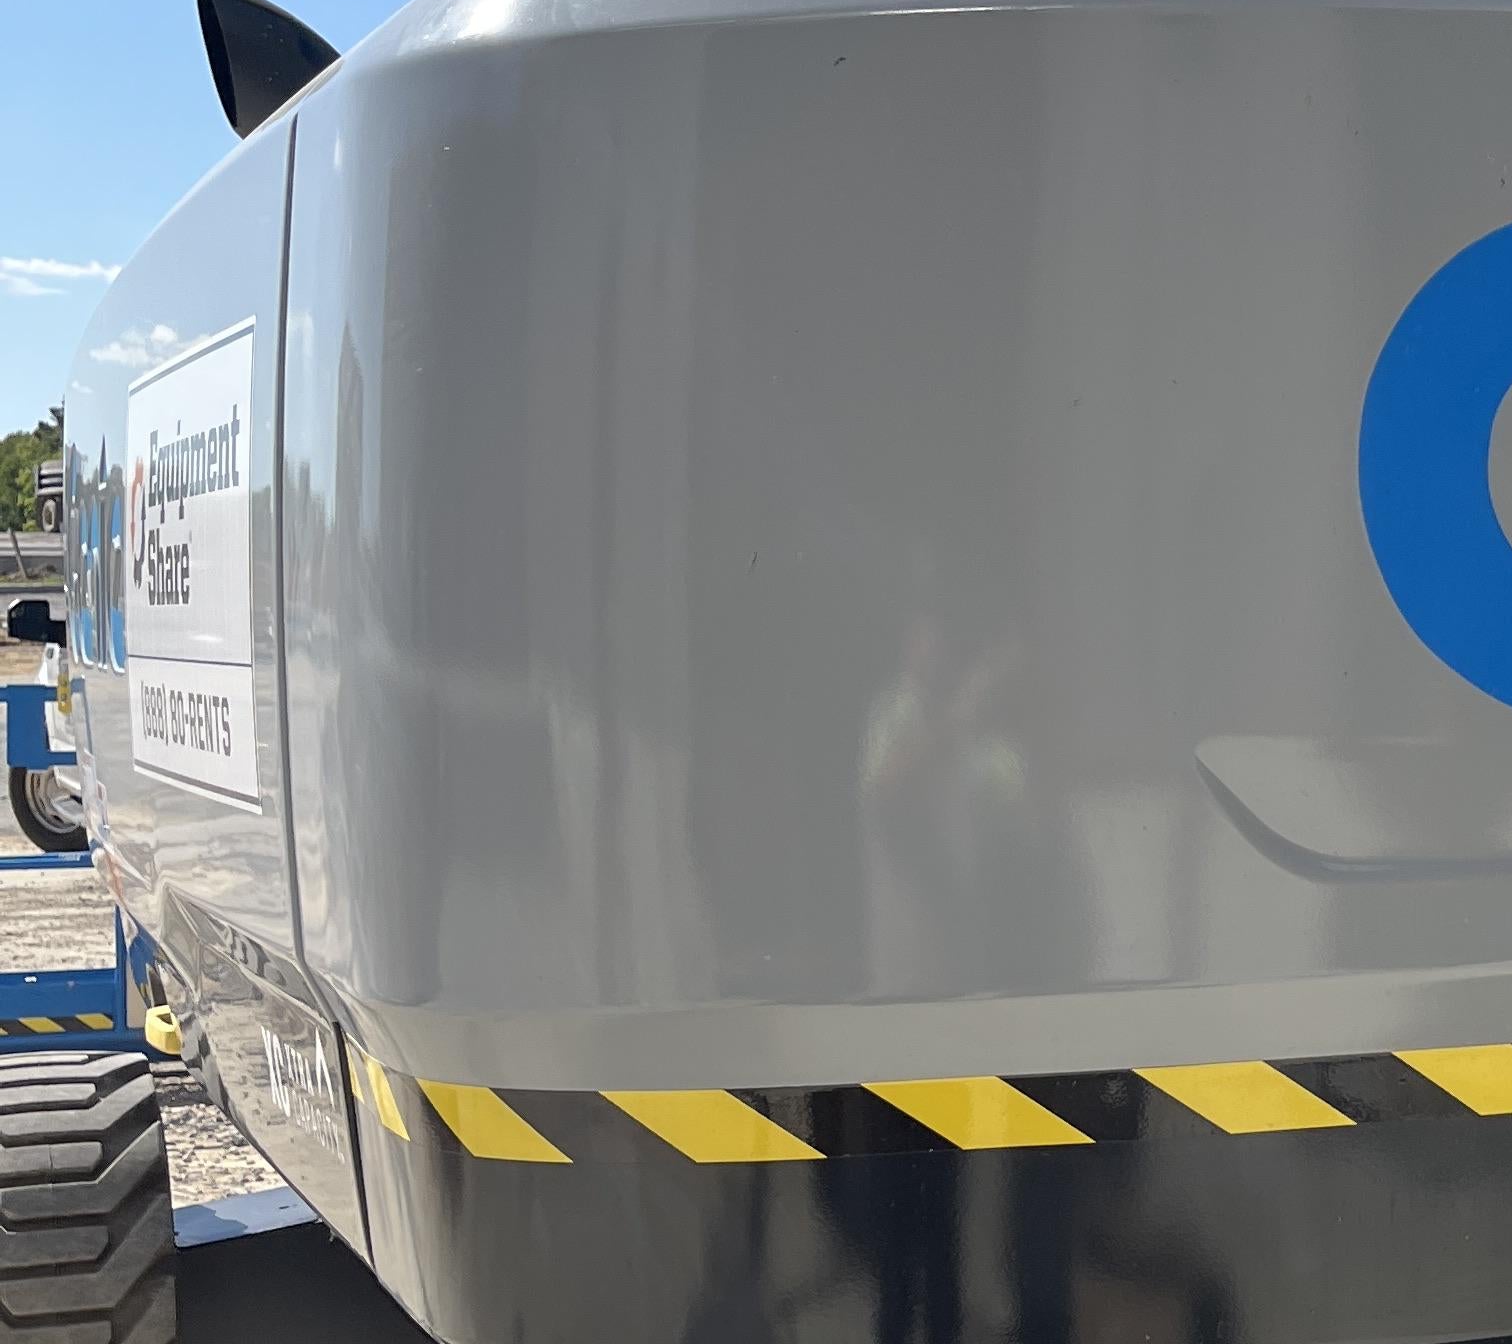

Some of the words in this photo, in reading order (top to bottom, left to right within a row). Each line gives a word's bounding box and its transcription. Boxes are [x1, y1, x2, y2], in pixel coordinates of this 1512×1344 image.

[148, 403, 240, 524] Equipment
[147, 528, 191, 606] Share
[140, 680, 169, 746] (888)
[169, 689, 232, 757] 80-RENTS
[260, 1025, 291, 1118] XC
